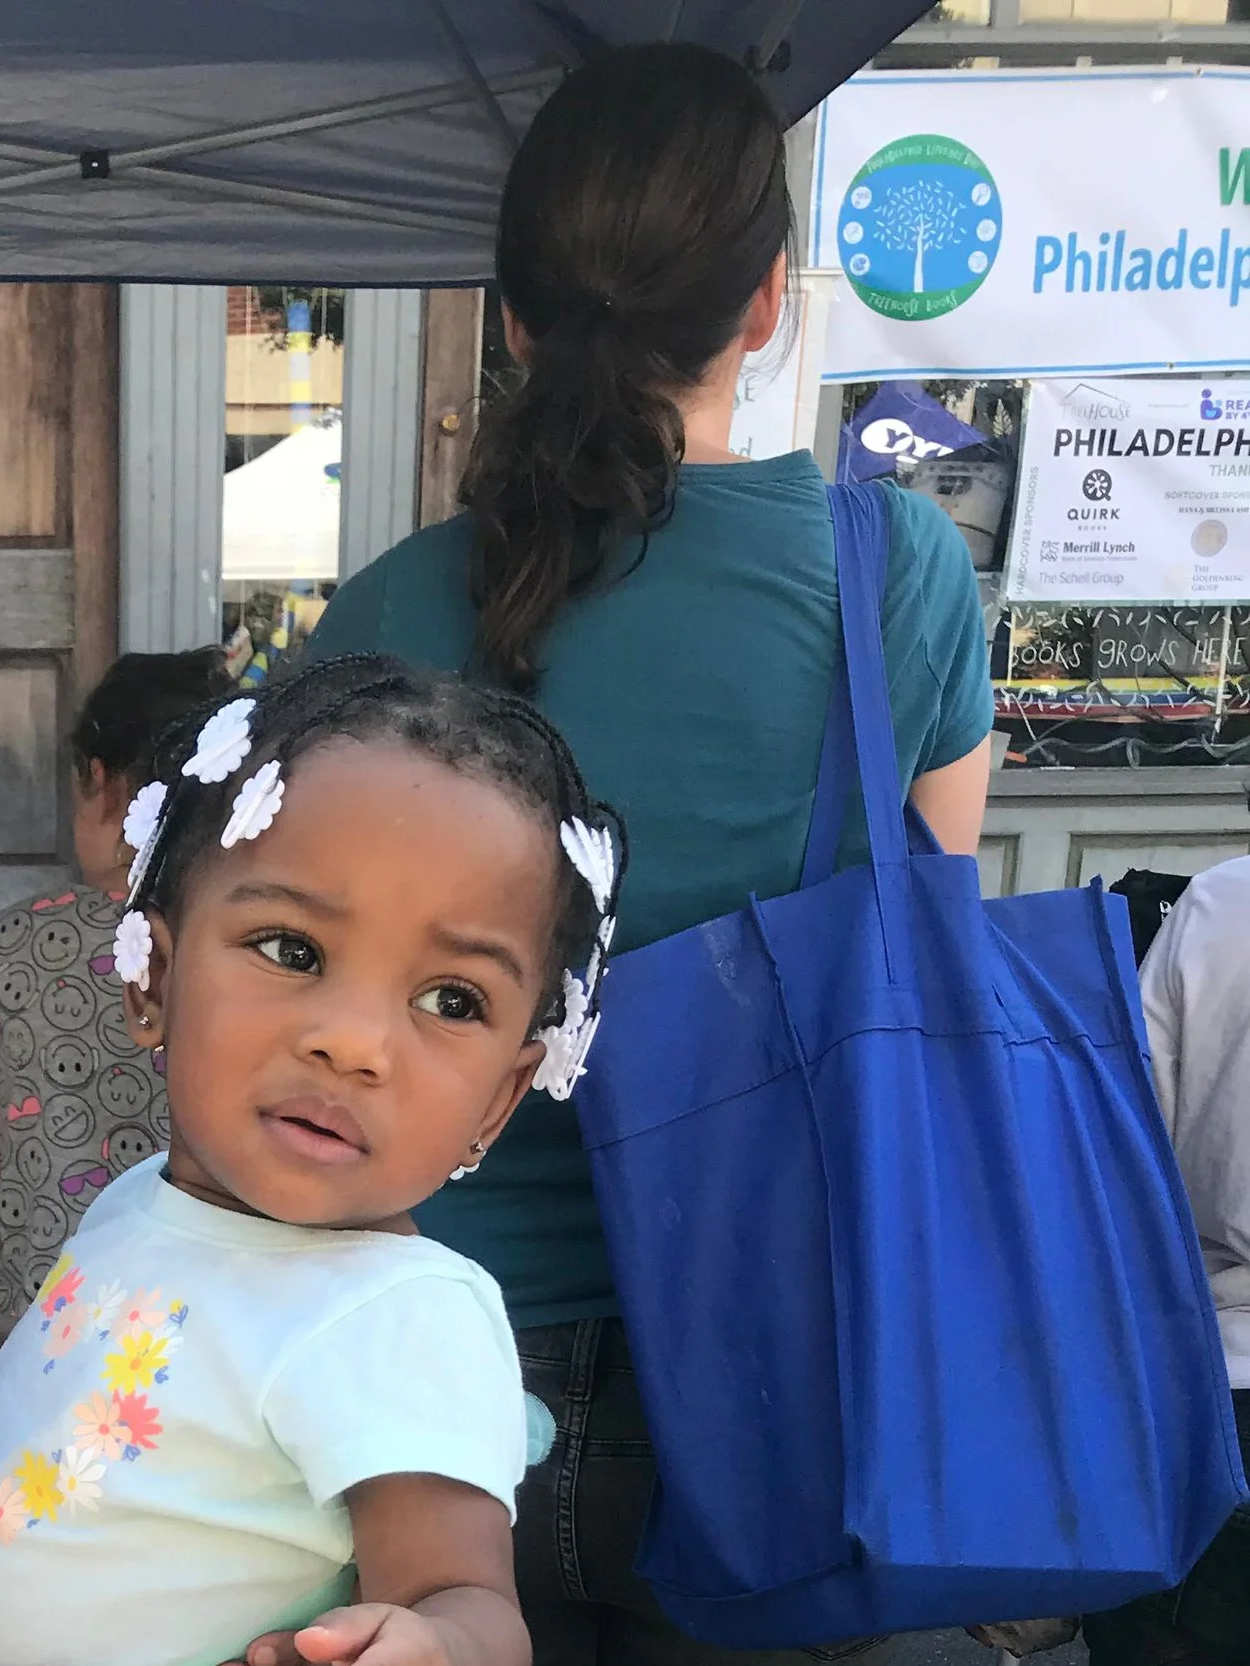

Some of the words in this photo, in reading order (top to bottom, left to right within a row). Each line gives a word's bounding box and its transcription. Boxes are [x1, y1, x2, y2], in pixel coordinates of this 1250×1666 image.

[1219, 147, 1250, 206] W
[1033, 228, 1250, 307] Philadelp
[1225, 400, 1250, 410] REA
[1053, 428, 1250, 457] PHILADELPH
[1208, 464, 1250, 477] THAN
[1067, 508, 1120, 520] QUIRK
[1063, 541, 1100, 553] Merrill
[1103, 541, 1135, 555] Lynch
[1039, 572, 1058, 584] The
[1092, 572, 1124, 586] Group
[1192, 637, 1247, 666] HERE
